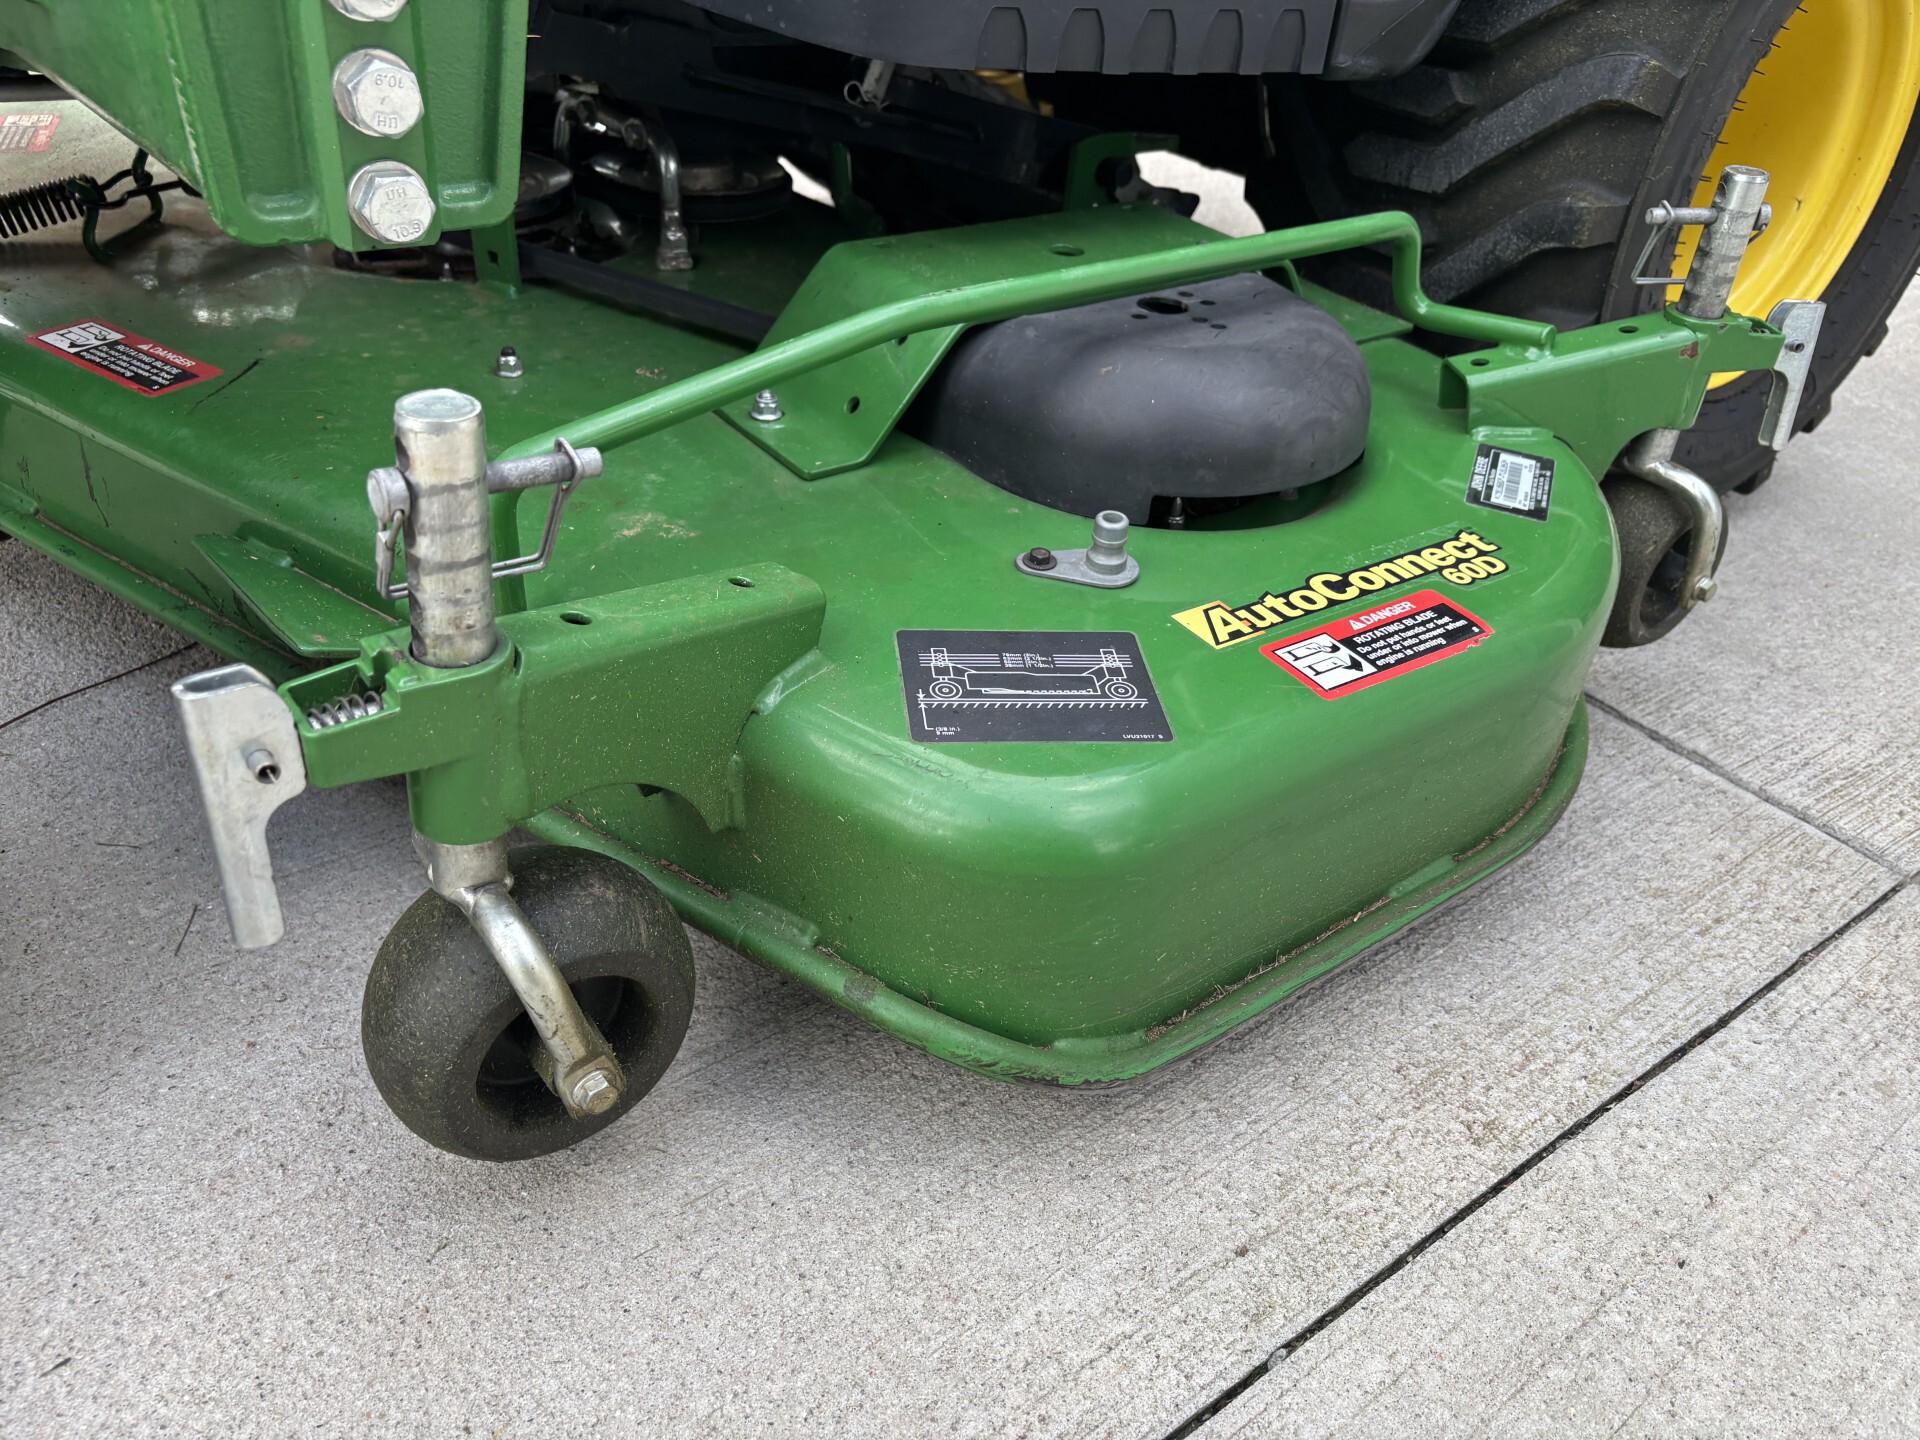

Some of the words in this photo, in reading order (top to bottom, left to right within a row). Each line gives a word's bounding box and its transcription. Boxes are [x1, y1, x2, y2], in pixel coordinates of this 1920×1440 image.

[375, 73, 404, 89] 10.9
[393, 222, 421, 239] 10.9
[114, 344, 156, 364] ROTATING
[152, 360, 183, 375] BLADE
[149, 346, 197, 368] DANGER
[1441, 555, 1507, 585] 60D
[1207, 531, 1499, 644] AutoConnect
[1353, 622, 1404, 644] ROTATING
[1402, 610, 1438, 627] BLADE
[1360, 601, 1416, 625] DANGER
[1356, 645, 1373, 654] Do
[1371, 640, 1388, 651] not
[1387, 636, 1401, 648] put
[1400, 626, 1427, 642] hands
[1434, 616, 1453, 627] feet
[1366, 646, 1392, 660] under
[1392, 643, 1402, 651] or
[1401, 636, 1420, 649] into
[1418, 628, 1447, 642] mower
[1444, 619, 1468, 632] when
[1376, 651, 1406, 666] engine
[1404, 648, 1415, 656] is
[1413, 637, 1447, 653] running
